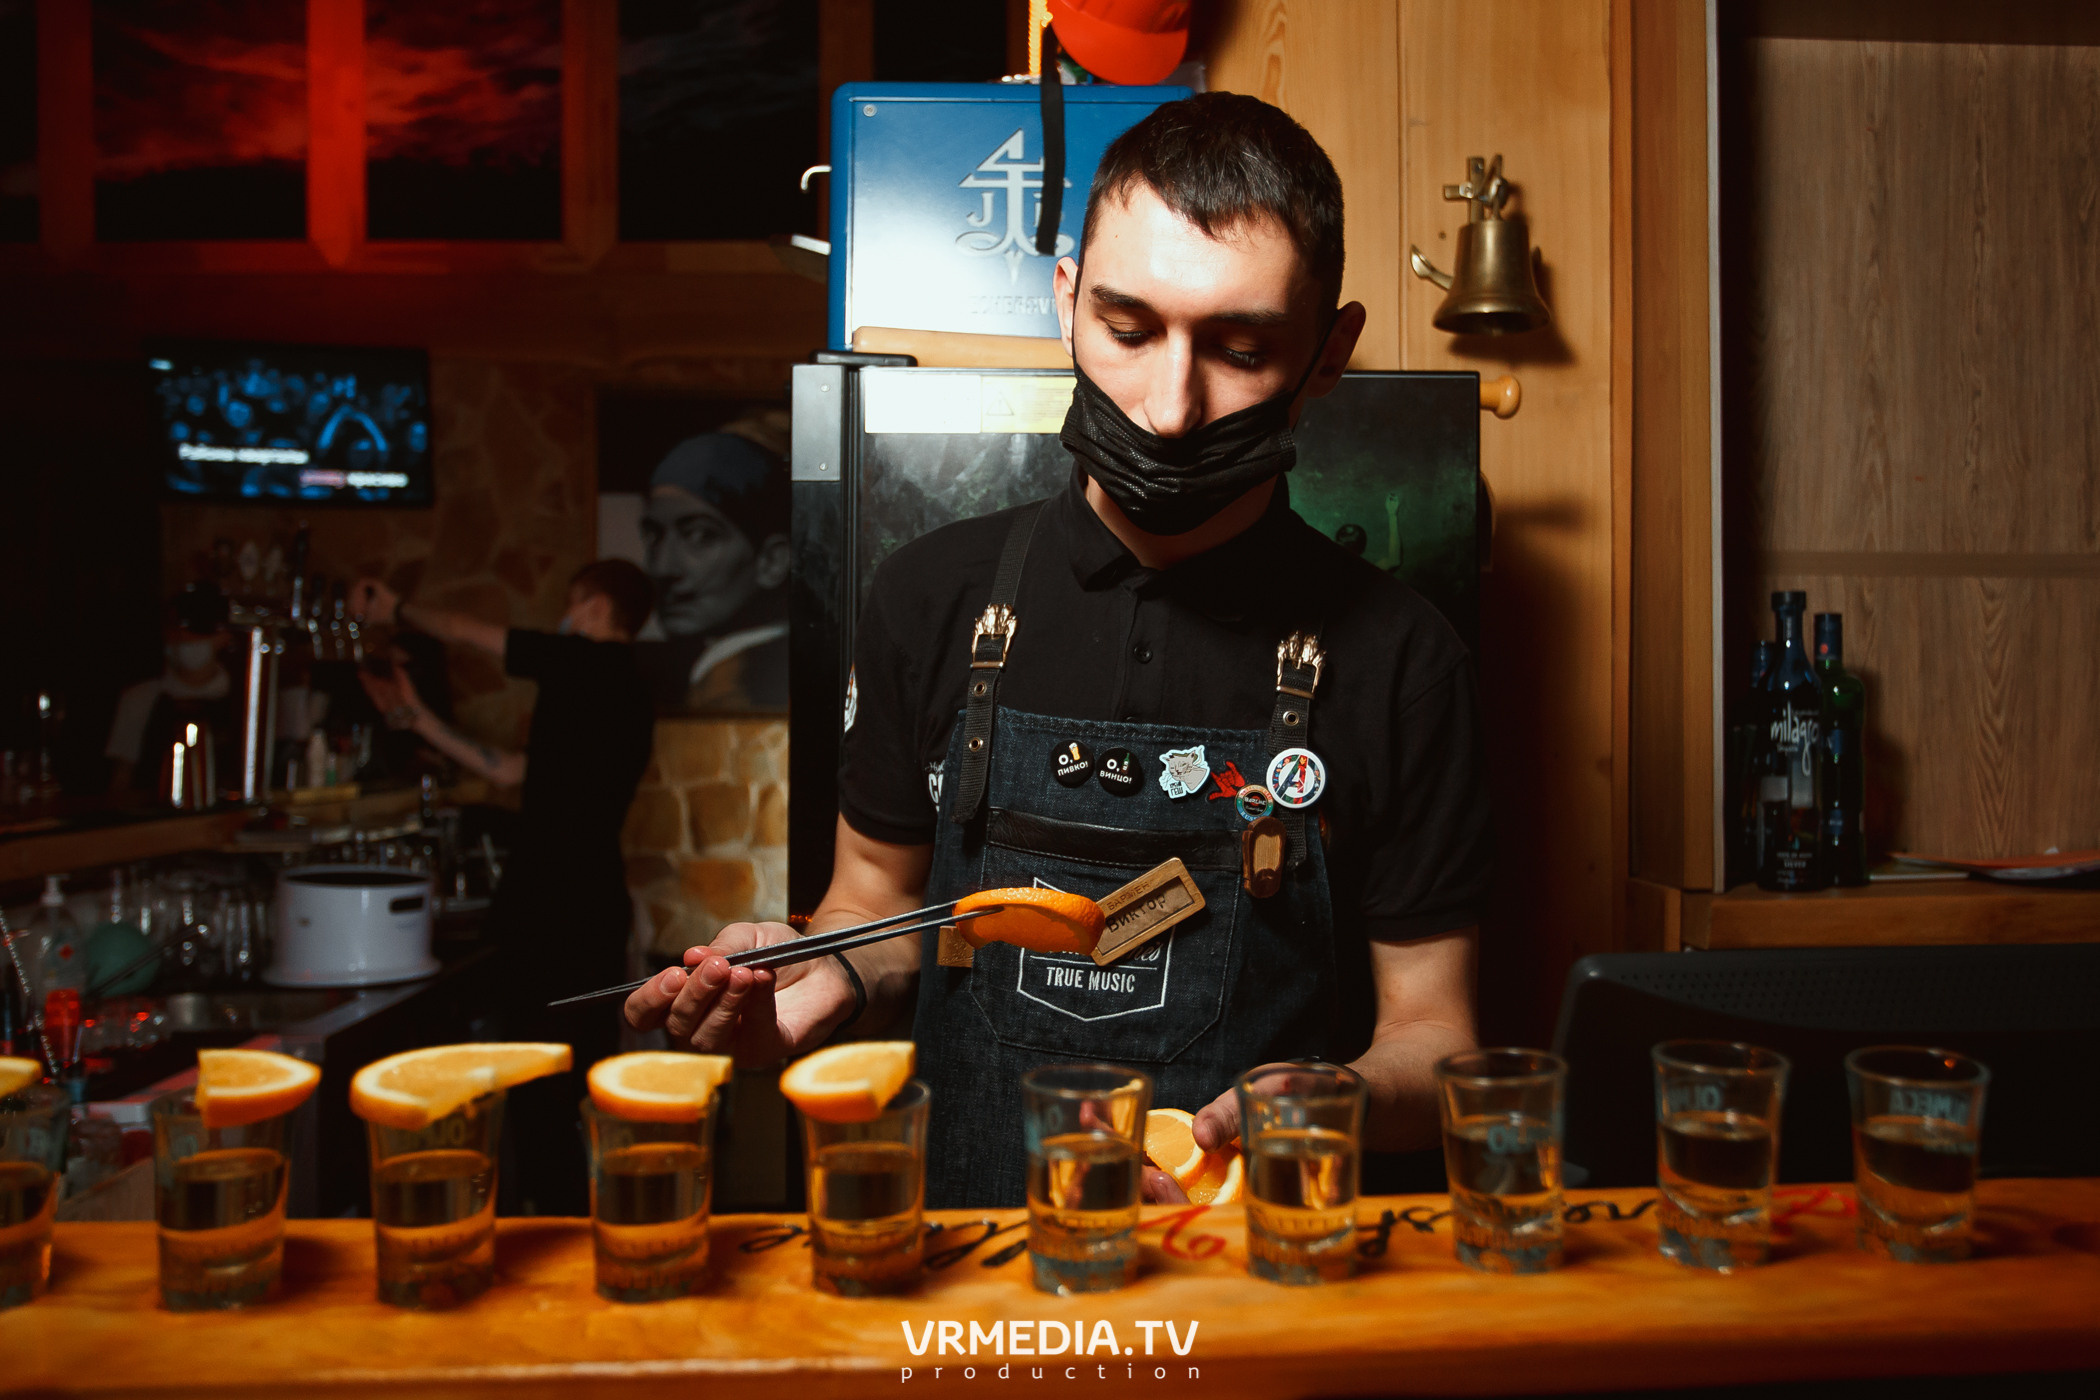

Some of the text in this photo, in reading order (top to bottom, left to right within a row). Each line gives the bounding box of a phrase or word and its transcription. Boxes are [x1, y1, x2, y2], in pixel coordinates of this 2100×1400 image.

[1770, 701, 1820, 777] milagro
[1057, 760, 1089, 777] ПИВКО!
[1099, 769, 1132, 784] ВИНЦО!
[1107, 881, 1151, 911] БАРМЕН
[1105, 894, 1167, 933] Виктор
[1046, 966, 1136, 993] TRUE MUSIC
